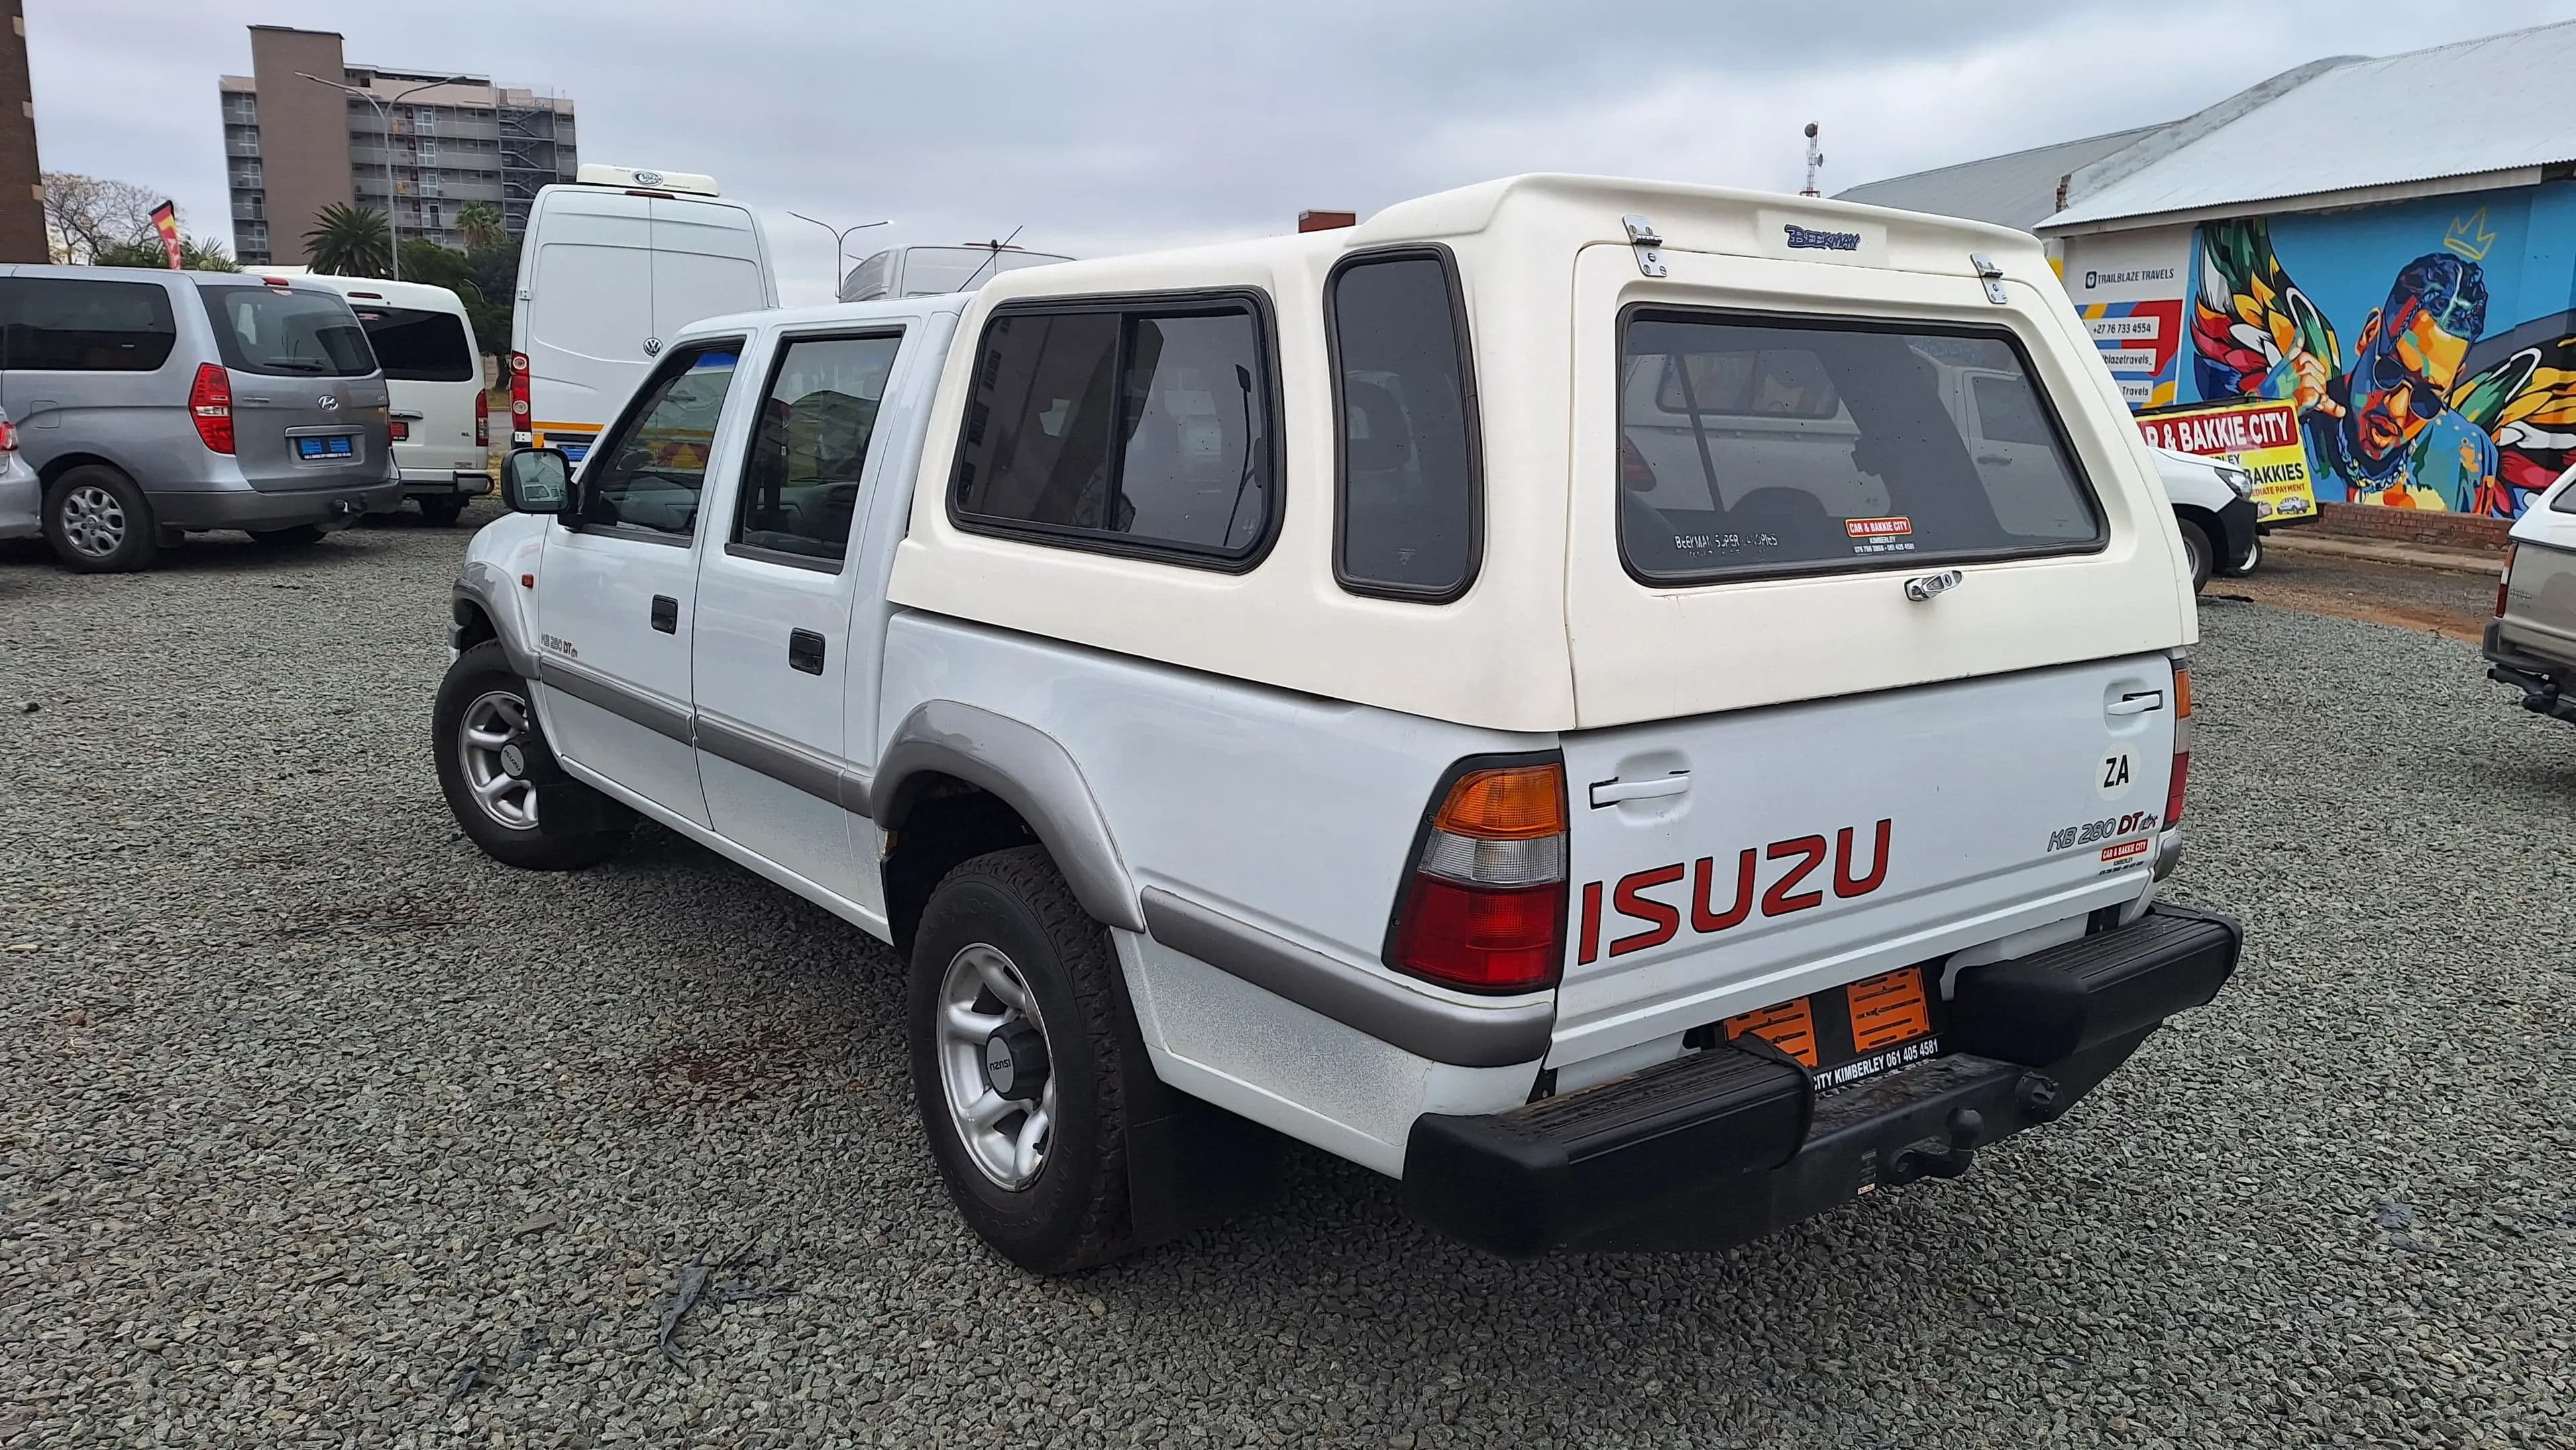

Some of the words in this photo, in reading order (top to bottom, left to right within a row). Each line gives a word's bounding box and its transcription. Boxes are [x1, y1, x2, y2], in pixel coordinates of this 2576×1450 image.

[1784, 224, 1860, 250] BEEKMAN
[2098, 270, 2139, 284] TRAILBLAZE
[2141, 268, 2174, 280] TRAVELS
[2093, 324, 2106, 334] +27
[2106, 324, 2116, 333] 76
[2117, 323, 2131, 333] 733
[2132, 323, 2151, 333] 4554
[2122, 386, 2149, 396] Travels
[2178, 415, 2245, 452] BAKKIE
[2249, 411, 2288, 445] CITY
[2275, 483, 2305, 494] PAYMENT
[1849, 523, 1863, 533] CAR
[1864, 523, 1870, 532] &
[1870, 521, 1893, 531] BAKKIE
[1893, 521, 1907, 531] CITY
[563, 641, 572, 655] DT
[2104, 754, 2129, 788] ZA
[2047, 827, 2077, 852] KB
[2078, 818, 2116, 845] 280
[2117, 811, 2144, 835] DT
[2102, 849, 2113, 859] CAR
[2135, 841, 2147, 851] CITY
[1578, 818, 1892, 966] ISUZU
[989, 1058, 1011, 1071] ISUZU
[1835, 1055, 1884, 1084] KIMBERLEY
[1886, 1049, 1901, 1067] 061
[1903, 1045, 1918, 1062] 405
[1919, 1038, 1938, 1057] 4581
